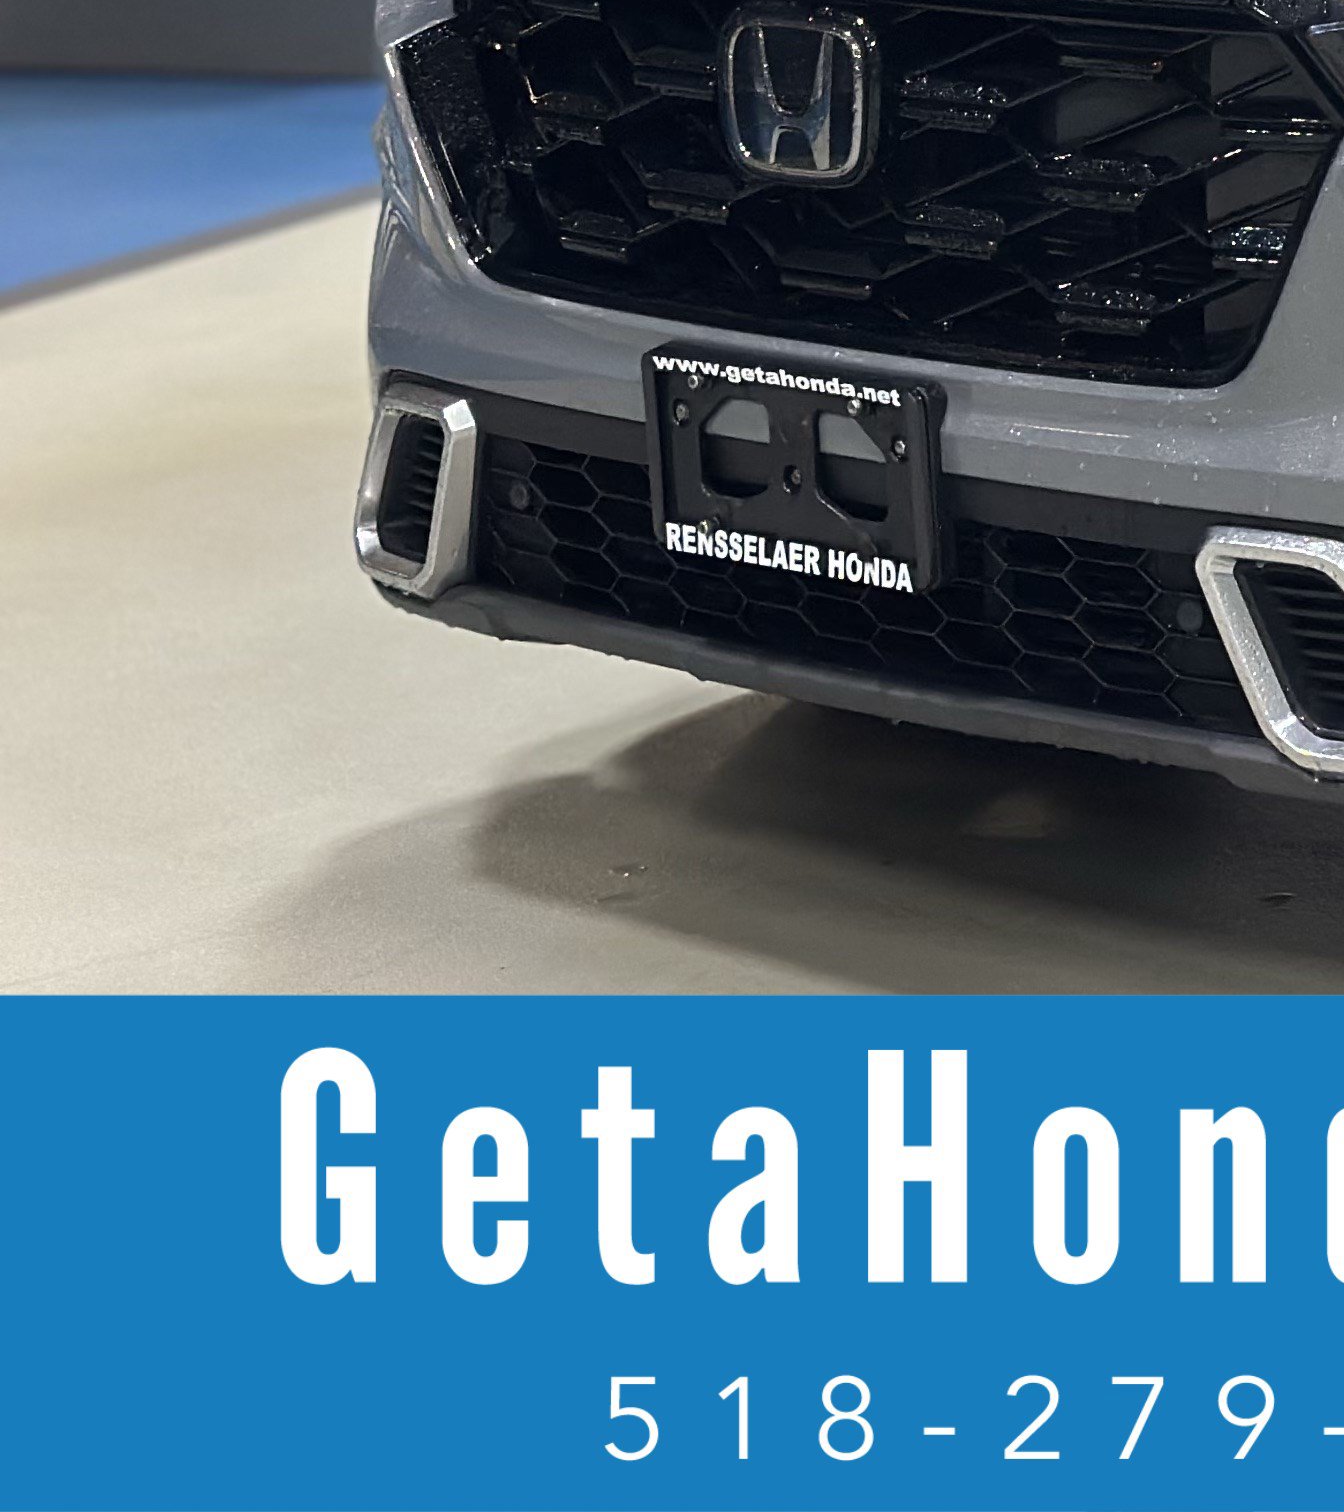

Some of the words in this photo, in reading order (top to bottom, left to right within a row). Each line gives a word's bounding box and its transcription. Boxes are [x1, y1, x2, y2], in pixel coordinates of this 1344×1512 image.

[652, 354, 902, 407] www.getahonda.net
[665, 521, 821, 576] RENSSELAER
[827, 548, 914, 593] HONDA
